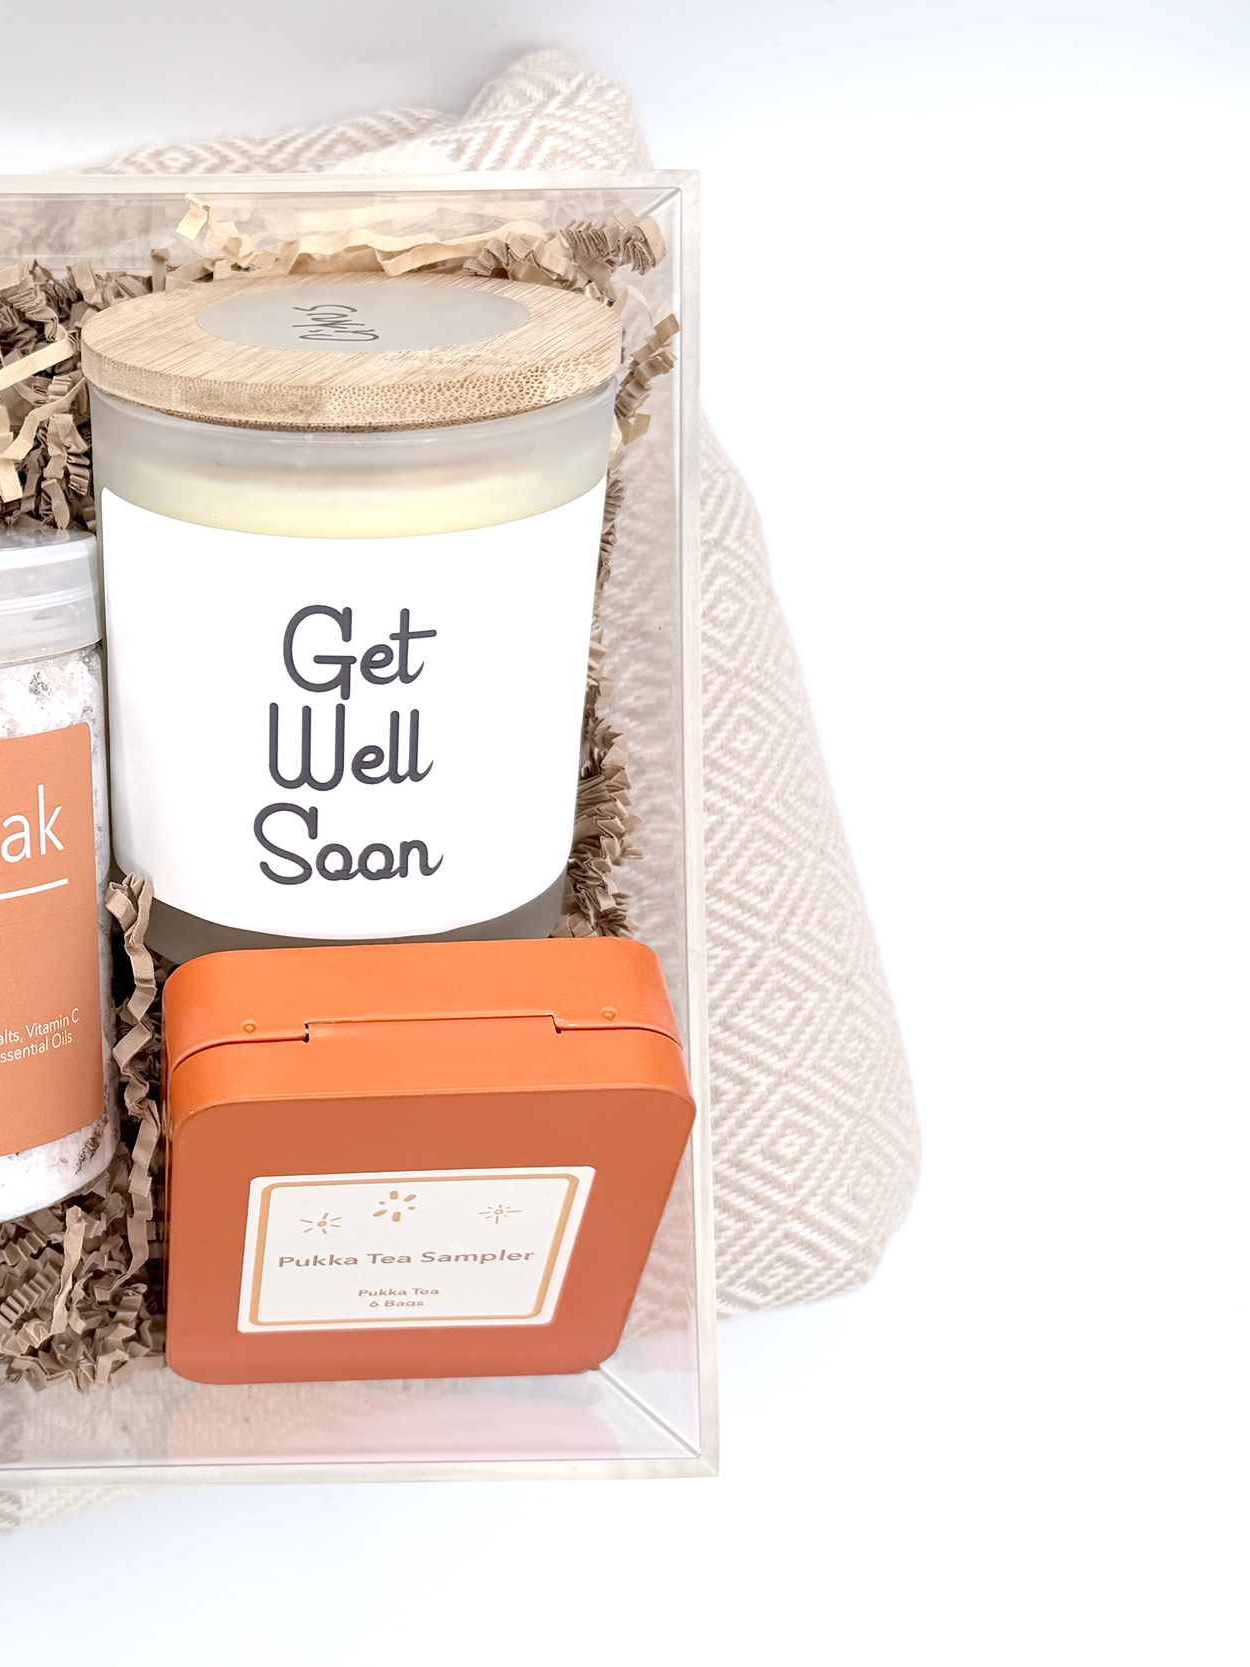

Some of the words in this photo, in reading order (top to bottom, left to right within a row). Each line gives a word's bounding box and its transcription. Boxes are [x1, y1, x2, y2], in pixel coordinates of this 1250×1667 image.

[282, 604, 437, 700] Get
[268, 702, 434, 791] Well
[253, 802, 444, 885] Soon
[25, 1014, 69, 1039] Vitamin
[71, 1007, 80, 1023] C
[51, 1030, 73, 1049] Oils
[277, 1252, 358, 1268] Pukka
[366, 1252, 411, 1265] Tea
[420, 1249, 535, 1267] Sampler
[358, 1288, 407, 1297] Pukka
[411, 1287, 439, 1295] Tea
